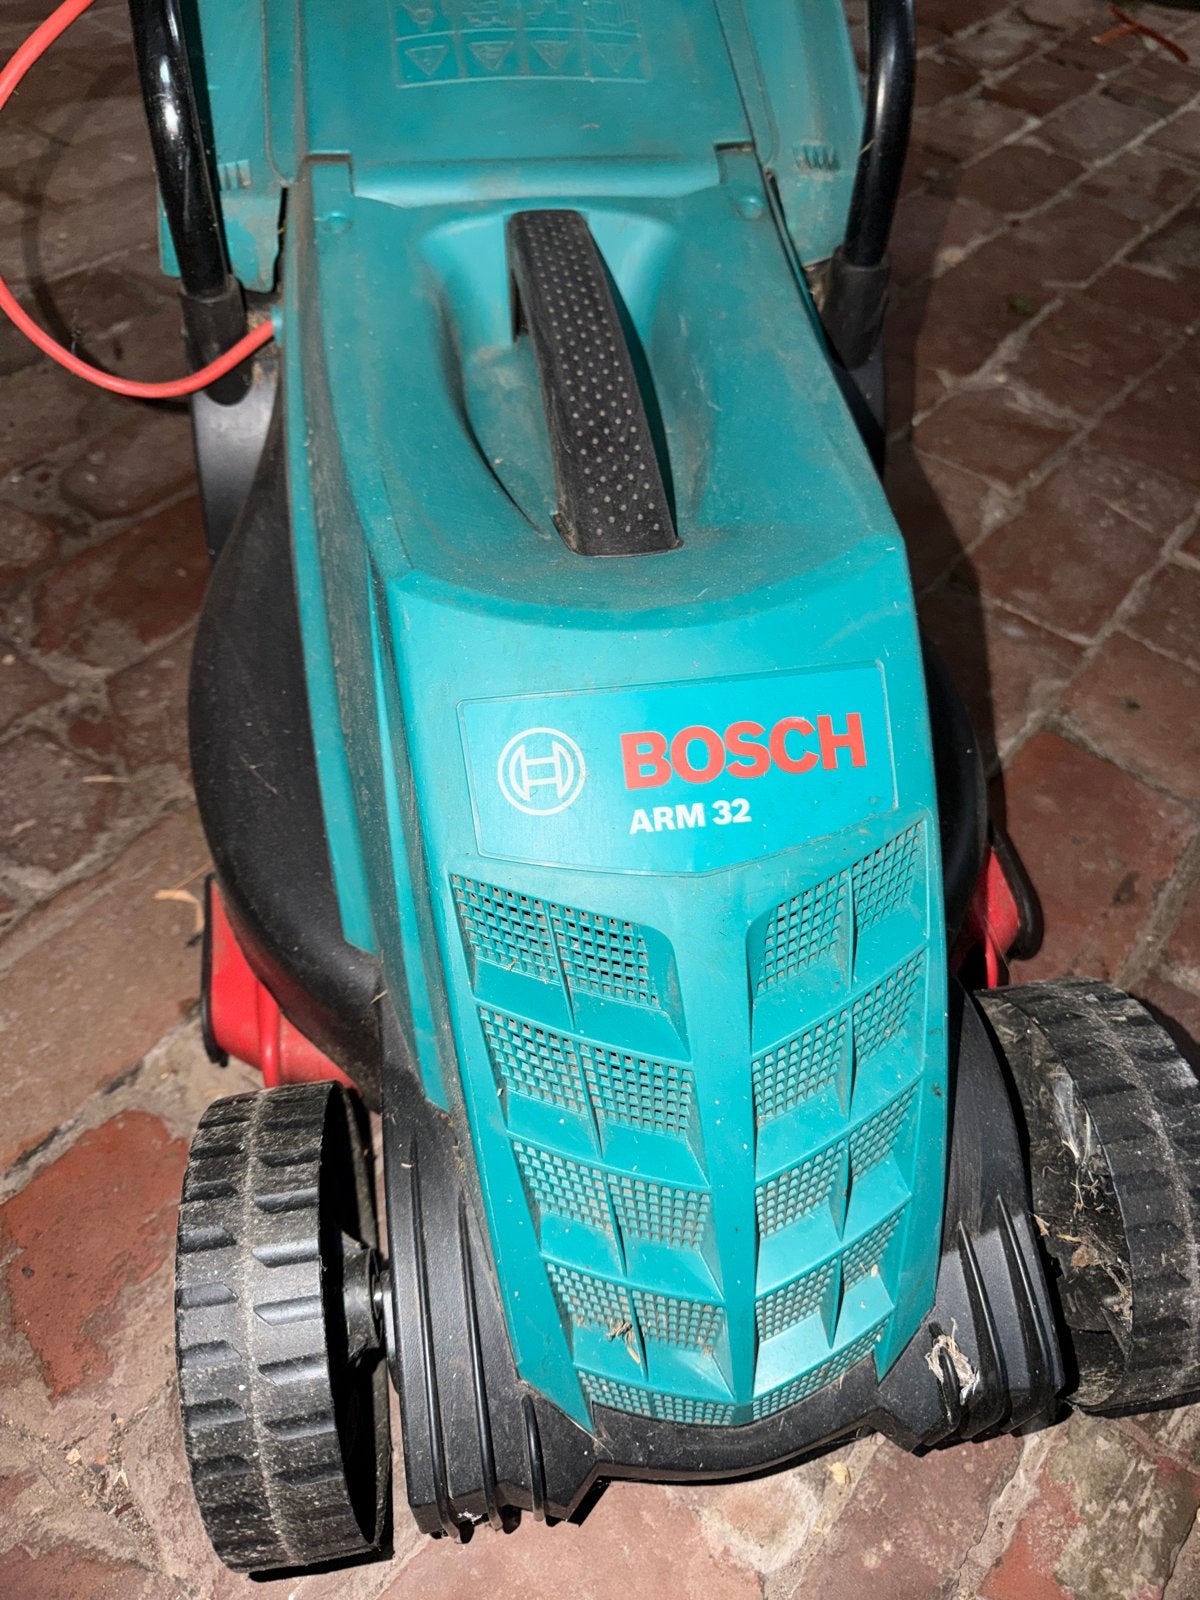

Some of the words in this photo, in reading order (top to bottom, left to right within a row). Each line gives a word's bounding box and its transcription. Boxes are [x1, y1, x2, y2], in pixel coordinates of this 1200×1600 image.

[620, 712, 867, 791] BOSCH
[629, 802, 706, 835] ARM
[712, 798, 752, 825] 32
